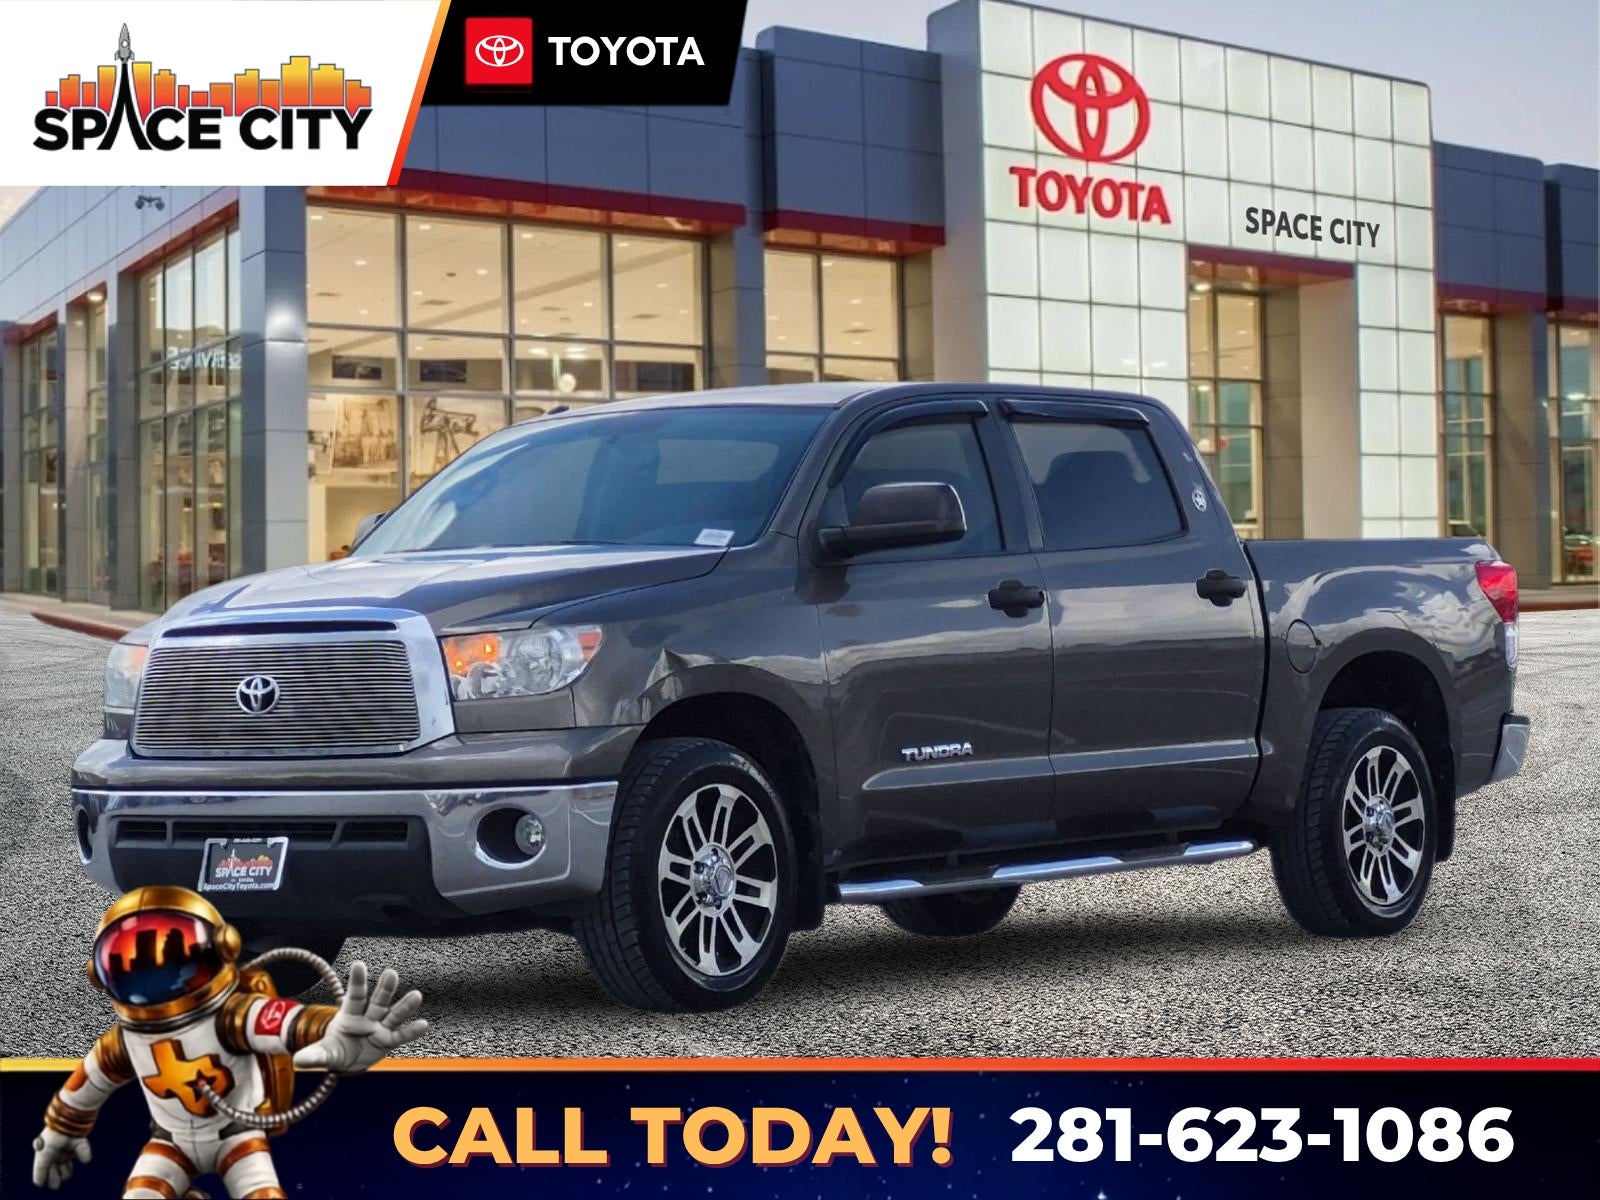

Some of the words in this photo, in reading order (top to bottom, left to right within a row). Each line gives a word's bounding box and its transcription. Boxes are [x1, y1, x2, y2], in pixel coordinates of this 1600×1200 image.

[1009, 166, 1171, 224] TOYOTA
[1245, 206, 1323, 241] SPACE
[1329, 218, 1381, 248] CITY
[901, 742, 974, 761] TUNDRA
[215, 867, 247, 878] SPACE
[249, 866, 272, 876] CITY
[203, 882, 274, 891] SpaceCityToyota.com
